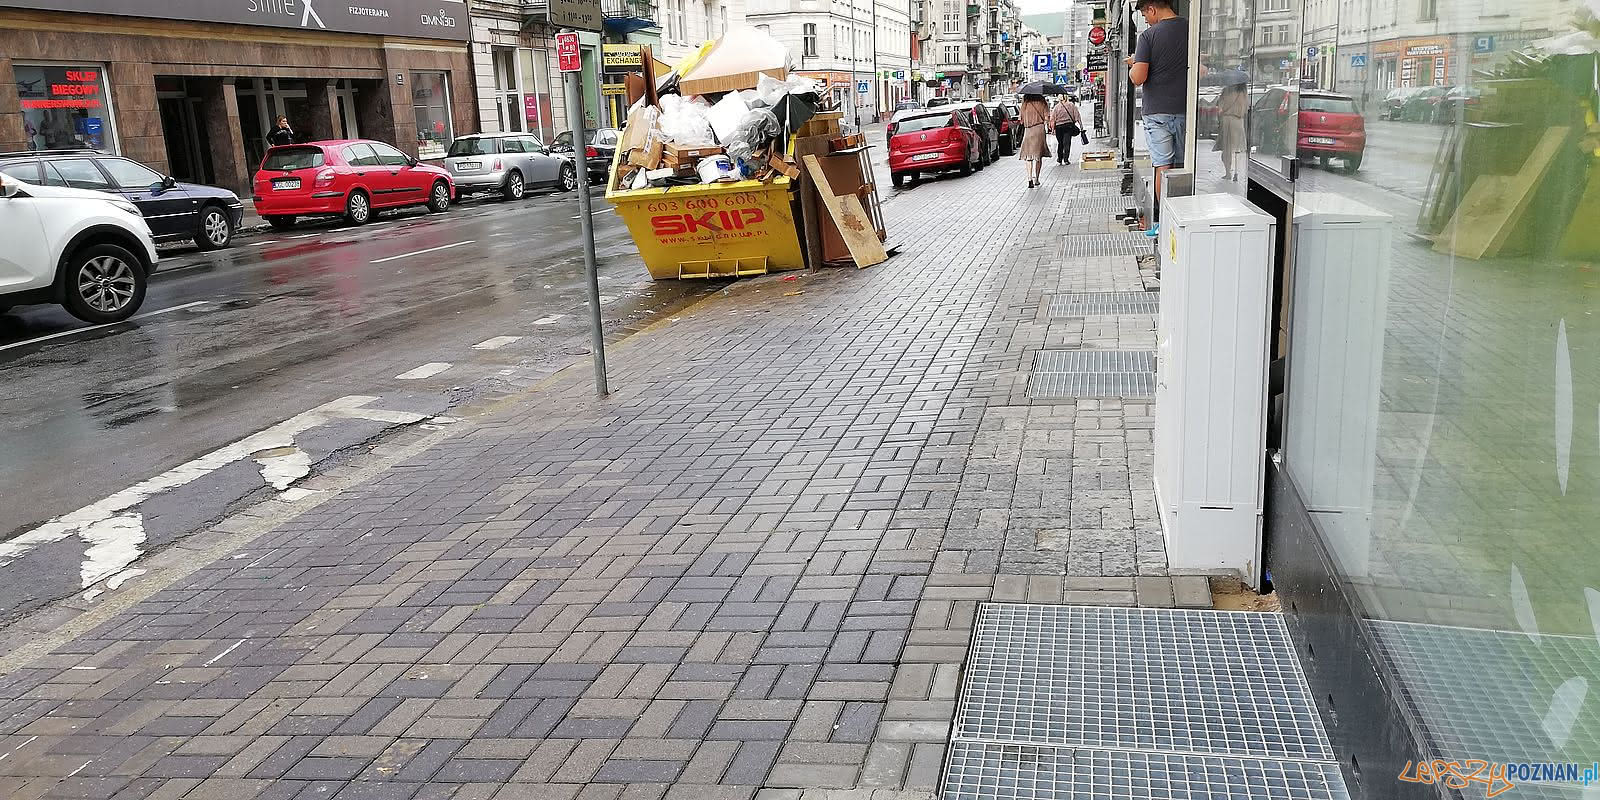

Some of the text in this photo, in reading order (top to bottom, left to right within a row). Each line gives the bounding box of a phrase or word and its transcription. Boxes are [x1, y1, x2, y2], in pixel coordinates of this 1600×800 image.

[348, 6, 390, 18] FIZJOTERAPIA
[1037, 55, 1048, 70] P
[65, 70, 97, 81] SKLEP
[51, 83, 99, 95] BIEGOWY
[648, 201, 679, 212] 603
[686, 198, 718, 210] 600
